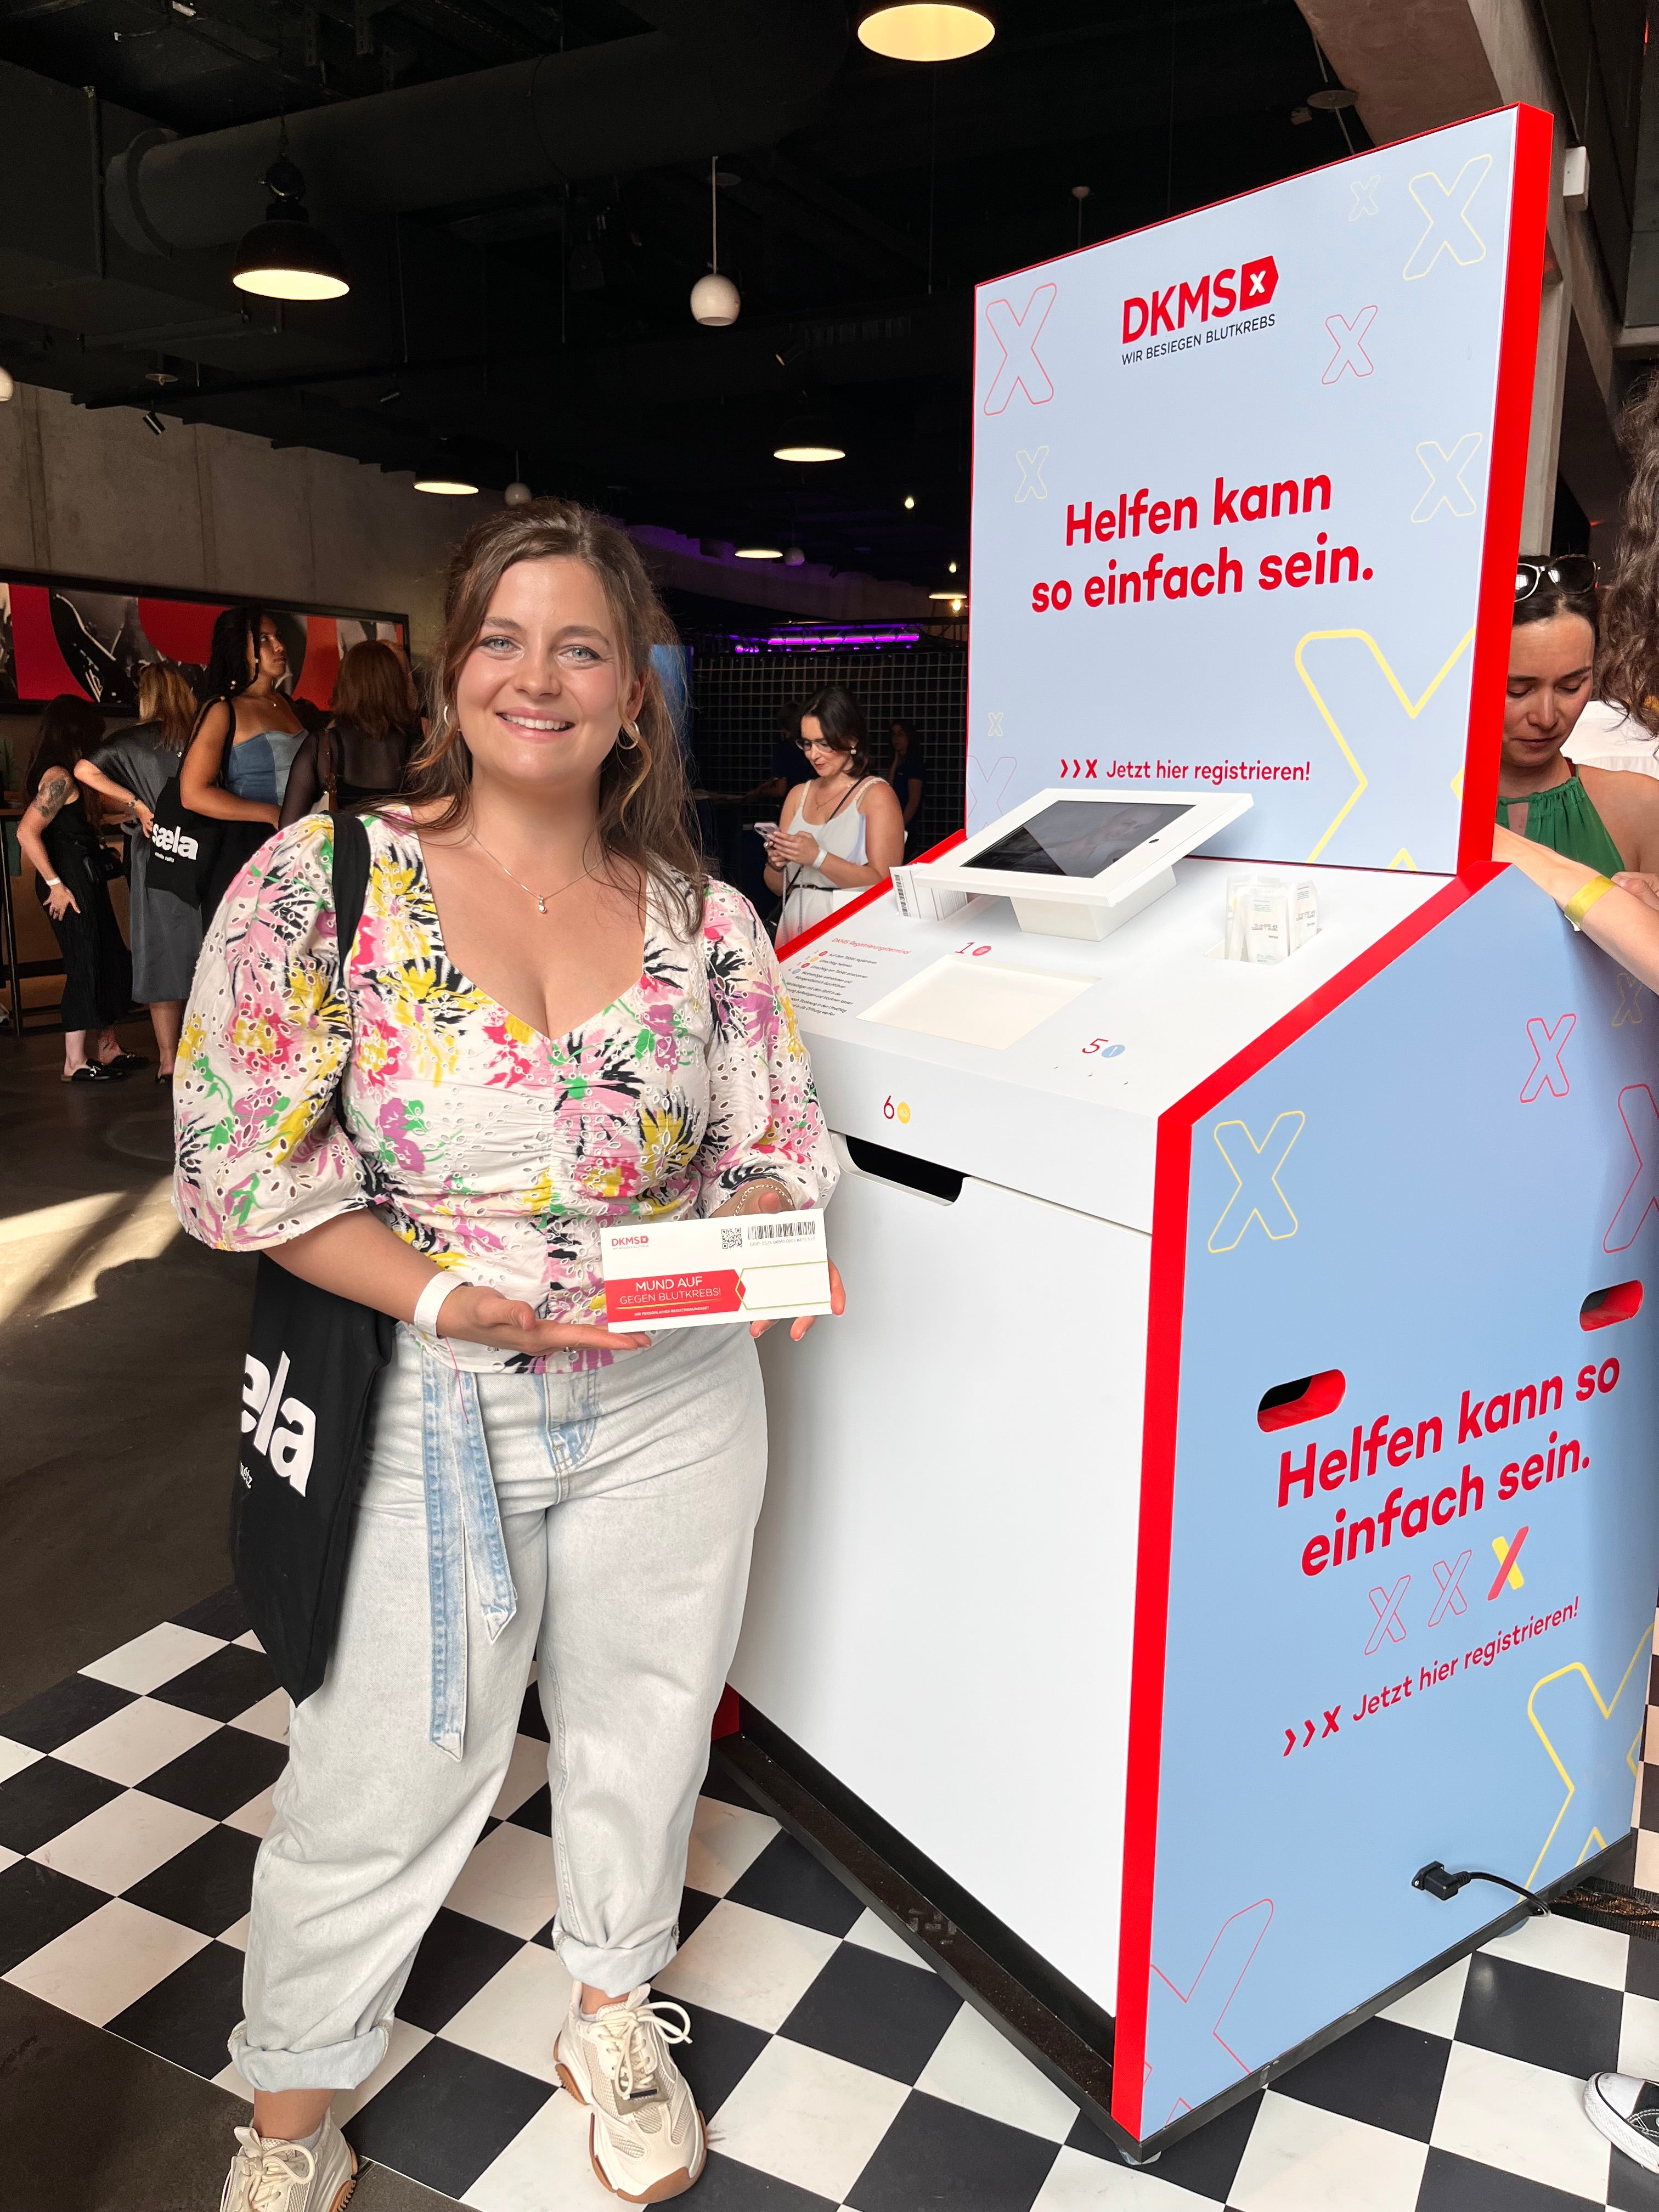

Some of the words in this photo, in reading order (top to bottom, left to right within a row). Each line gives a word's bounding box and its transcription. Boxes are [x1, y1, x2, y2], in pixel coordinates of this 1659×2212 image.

[1121, 268, 1237, 345] DKMS
[1122, 349, 1143, 365] WIR
[1147, 334, 1202, 359] BESIEGEN
[1206, 314, 1276, 343] BLUTKREBS
[1065, 489, 1198, 546] Helfen
[1213, 474, 1332, 526] kann
[1032, 579, 1072, 613] so
[1084, 546, 1243, 607] einfach
[1259, 532, 1374, 590] sein.
[1107, 760, 1150, 778] Jetzt
[1156, 759, 1189, 779] hier
[1194, 760, 1311, 786] registrieren!
[1082, 1039, 1109, 1054] 5
[883, 1095, 895, 1119] 6
[612, 1236, 640, 1246] DKMS
[619, 1293, 656, 1305] GEGEN
[659, 1287, 721, 1301] BLUTKREBS!
[635, 1279, 674, 1292] MUND
[677, 1276, 703, 1288] AUF
[1278, 1414, 1443, 1508] Helfen
[1457, 1374, 1564, 1444] kann
[1576, 1356, 1620, 1402] so
[1301, 1464, 1485, 1576] einfach
[1498, 1430, 1590, 1500] sein.
[1352, 1675, 1413, 1722] Jetzt
[1419, 1656, 1458, 1692] hier
[1464, 1595, 1579, 1671] registrieren!
